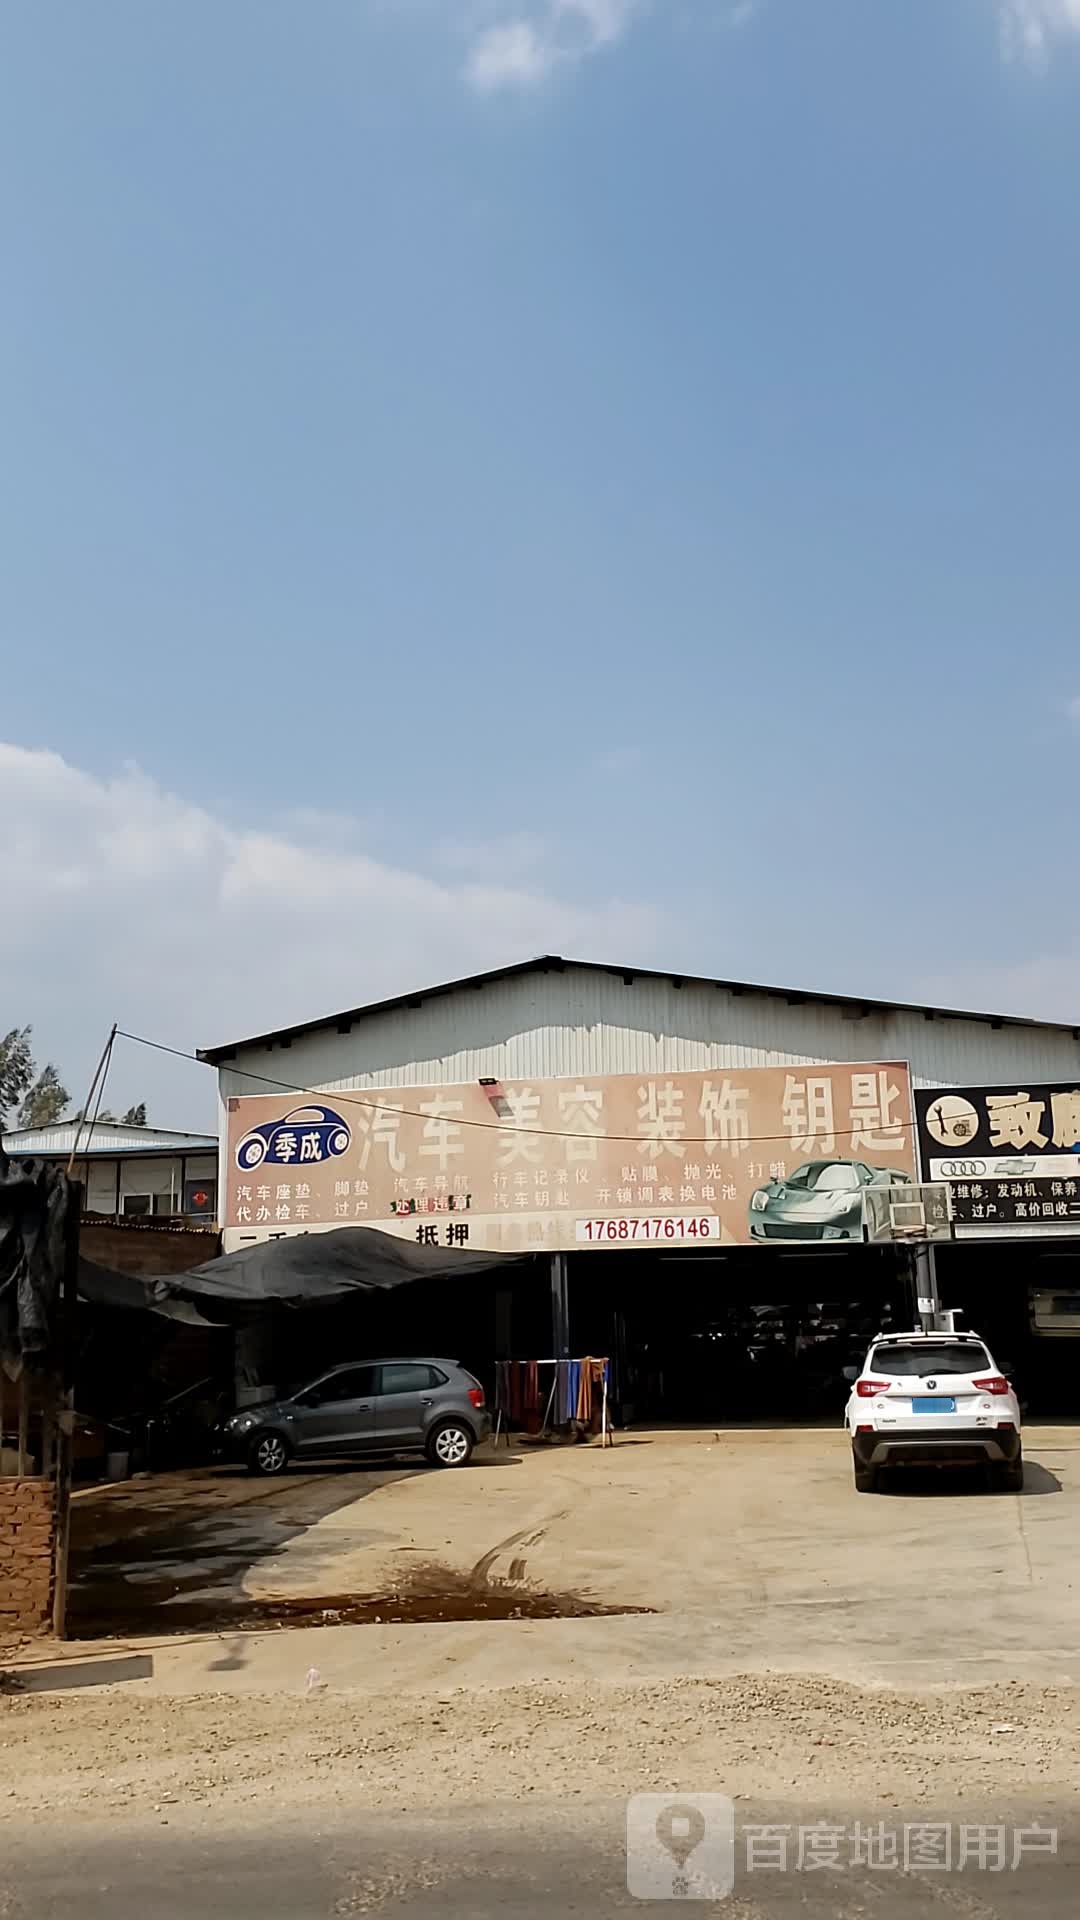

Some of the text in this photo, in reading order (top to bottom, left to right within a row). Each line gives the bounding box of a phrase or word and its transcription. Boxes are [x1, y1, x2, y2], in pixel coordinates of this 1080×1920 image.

[275, 1131, 323, 1162] 季成
[416, 1223, 469, 1247] 抵押
[584, 1218, 710, 1241] 17687176146
